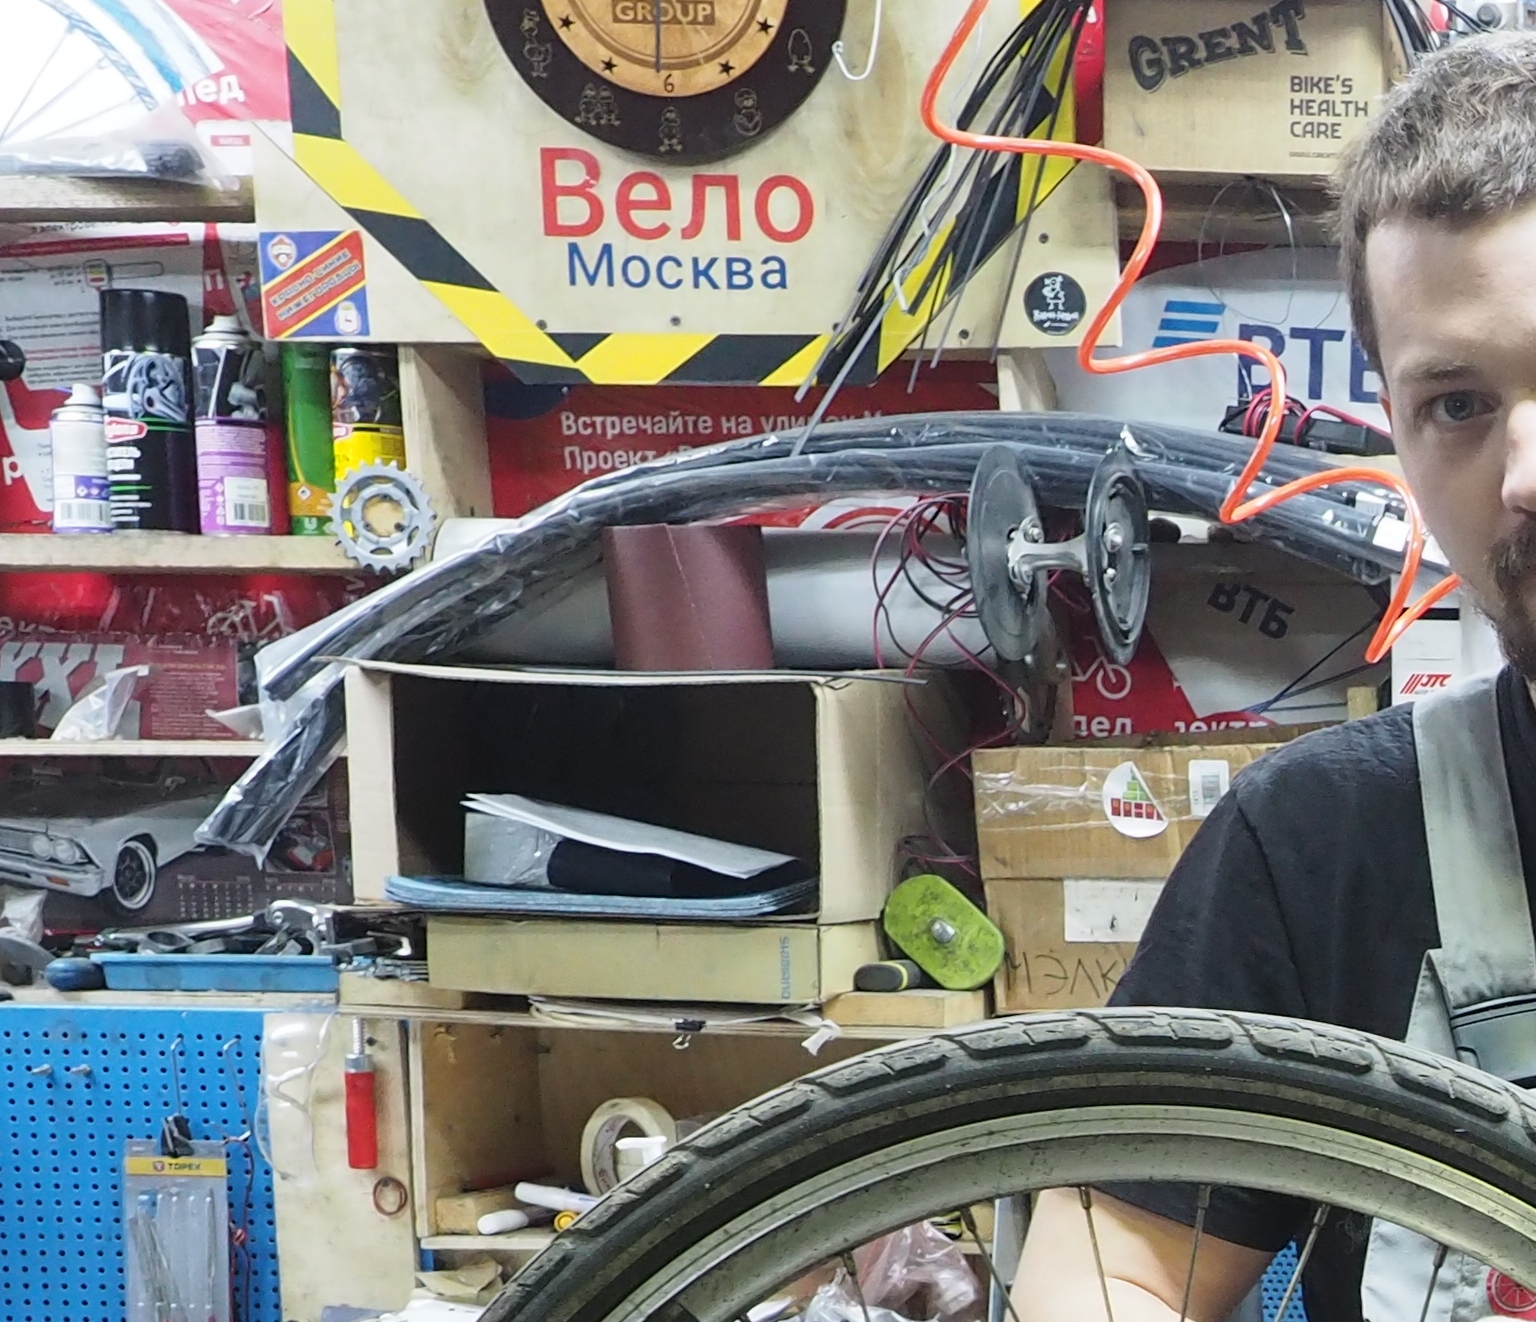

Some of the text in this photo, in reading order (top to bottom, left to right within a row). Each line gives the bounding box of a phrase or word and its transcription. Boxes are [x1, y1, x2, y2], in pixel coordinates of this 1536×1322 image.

[613, 0, 715, 22] GROUP
[1127, 0, 1309, 93] GRENT
[663, 74, 675, 93] 6
[1289, 75, 1353, 95] BIKE'S
[1289, 98, 1369, 117] HEALTH
[1289, 121, 1342, 139] CARE
[540, 147, 814, 243] Вело
[567, 242, 788, 290] Москва
[561, 410, 713, 437] Встречайте
[721, 414, 753, 435] на
